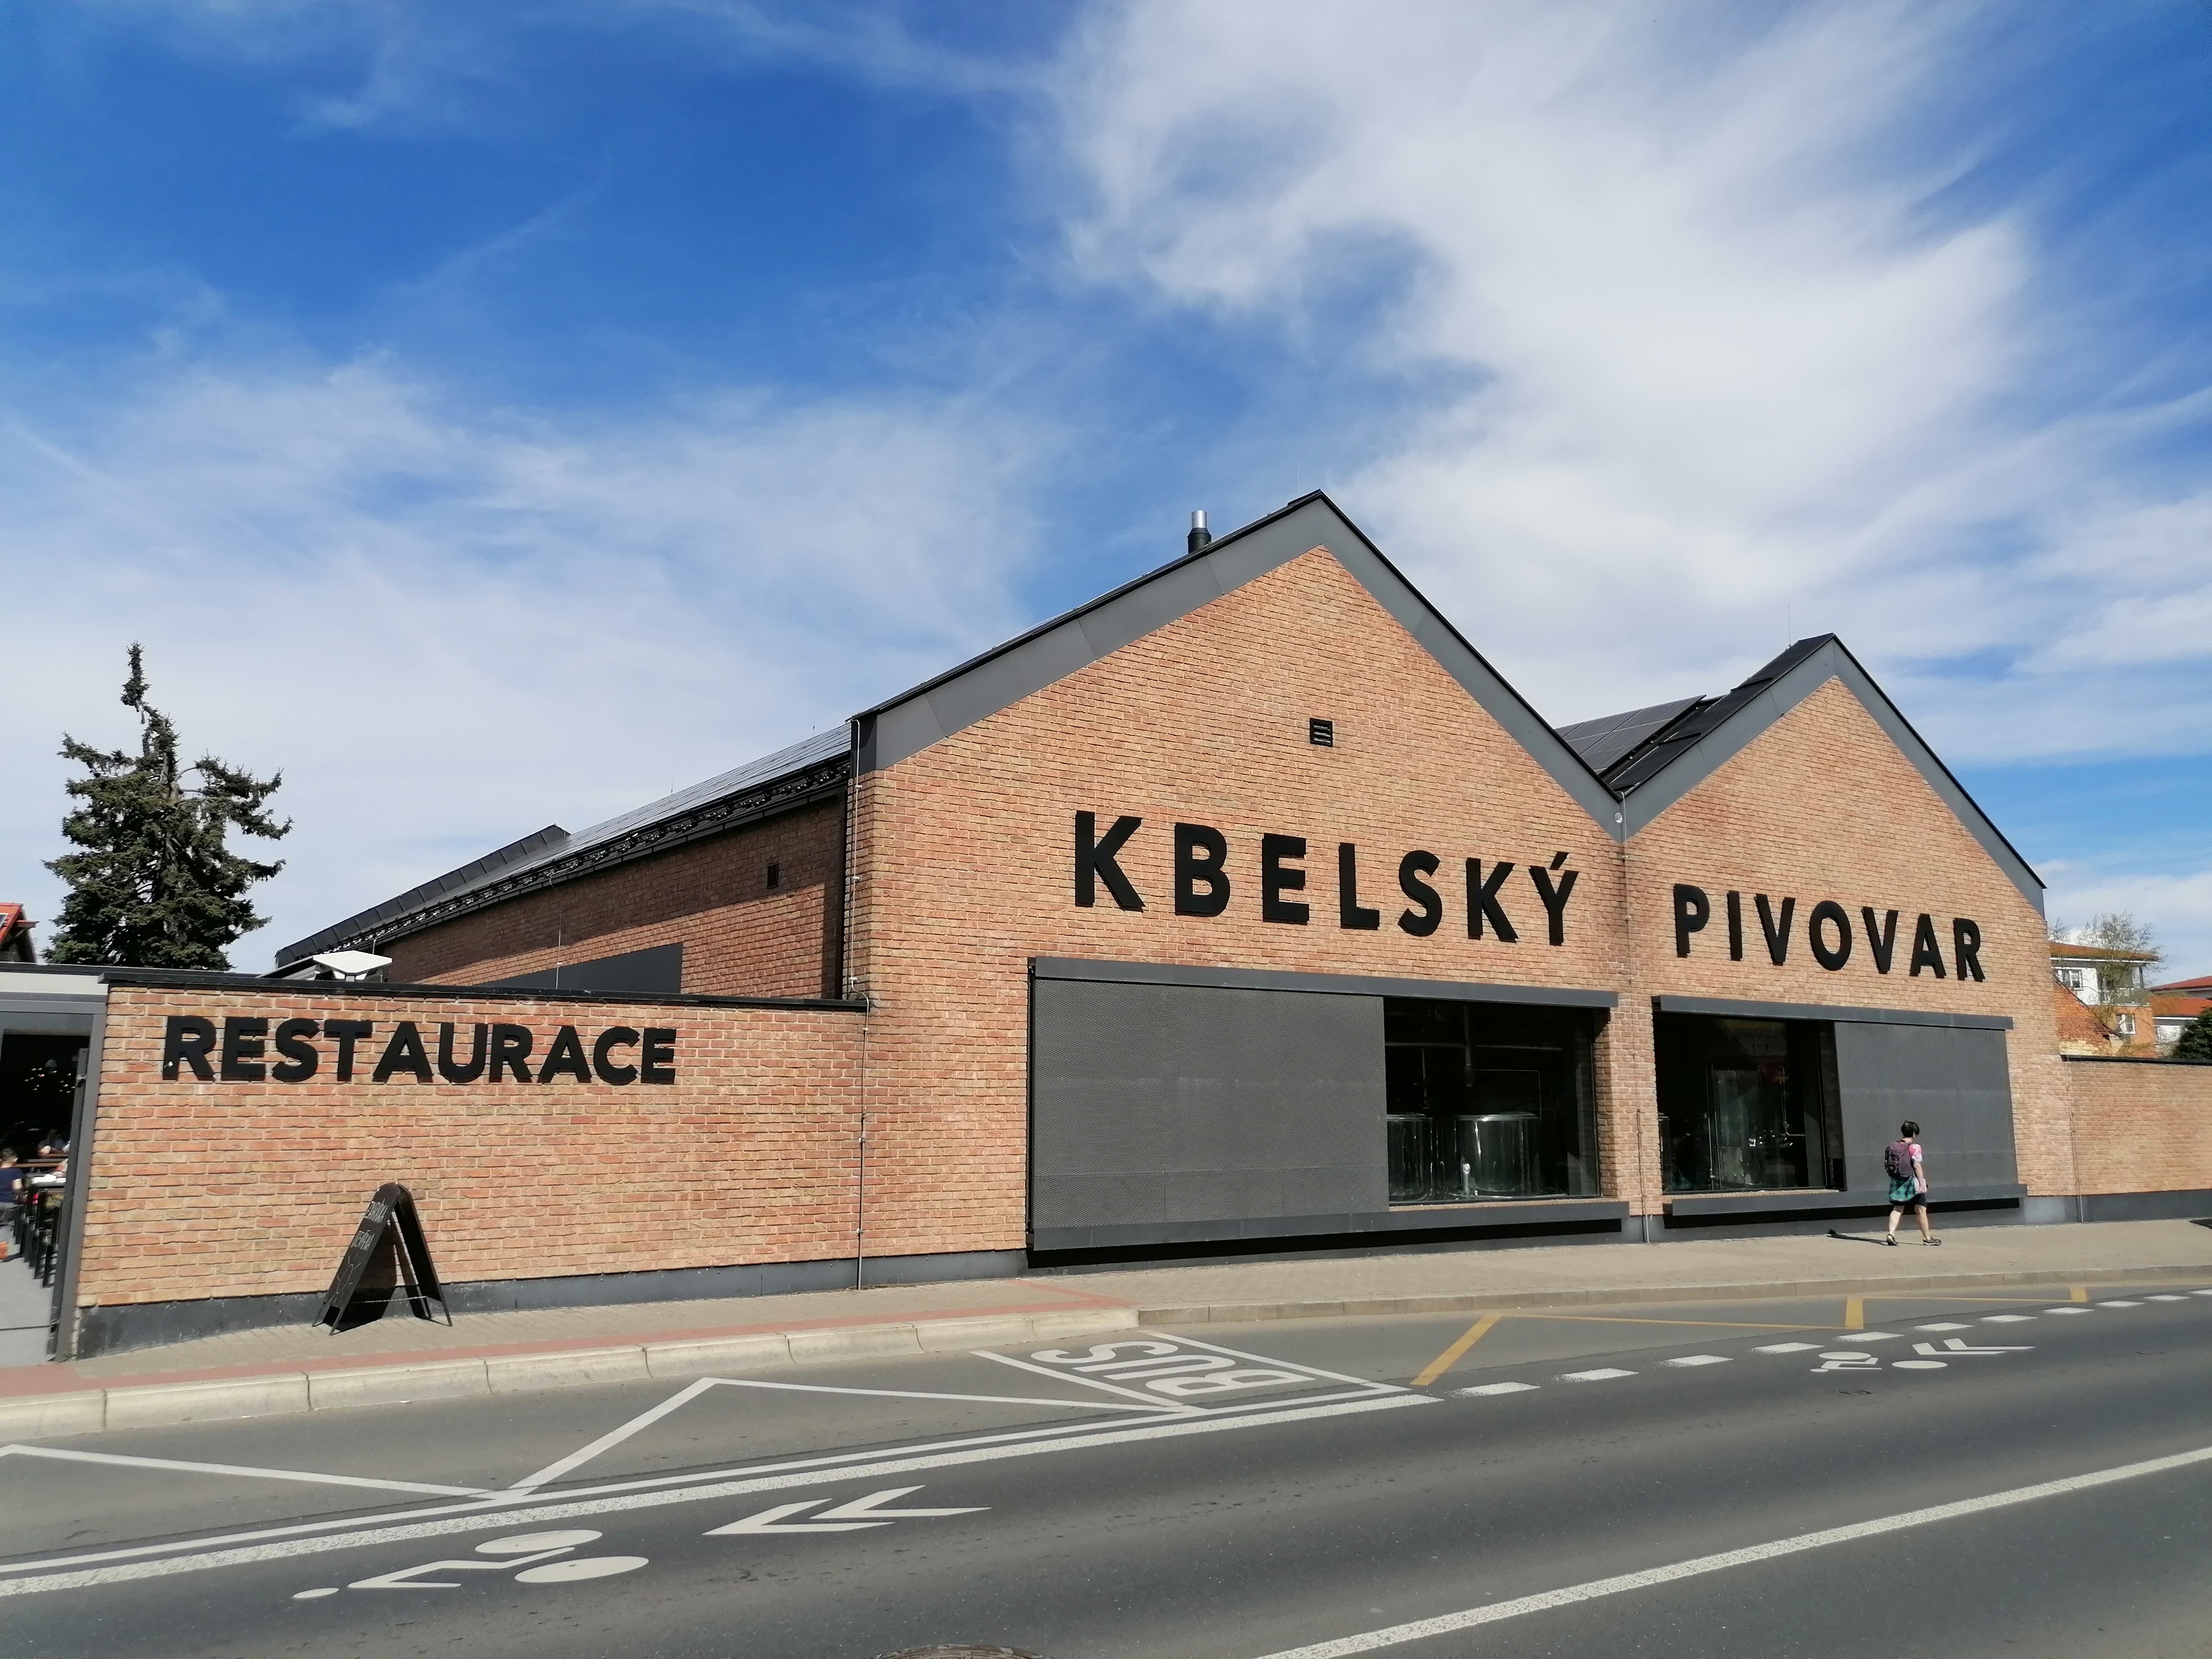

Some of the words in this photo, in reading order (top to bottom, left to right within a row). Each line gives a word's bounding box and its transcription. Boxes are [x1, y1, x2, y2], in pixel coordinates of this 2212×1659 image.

[1075, 810, 1578, 946] KBELSKÝ
[1673, 884, 1985, 982] PIVOVAR
[163, 1015, 676, 1085] RESTAURACE
[1031, 1340, 1316, 1396] BUS
